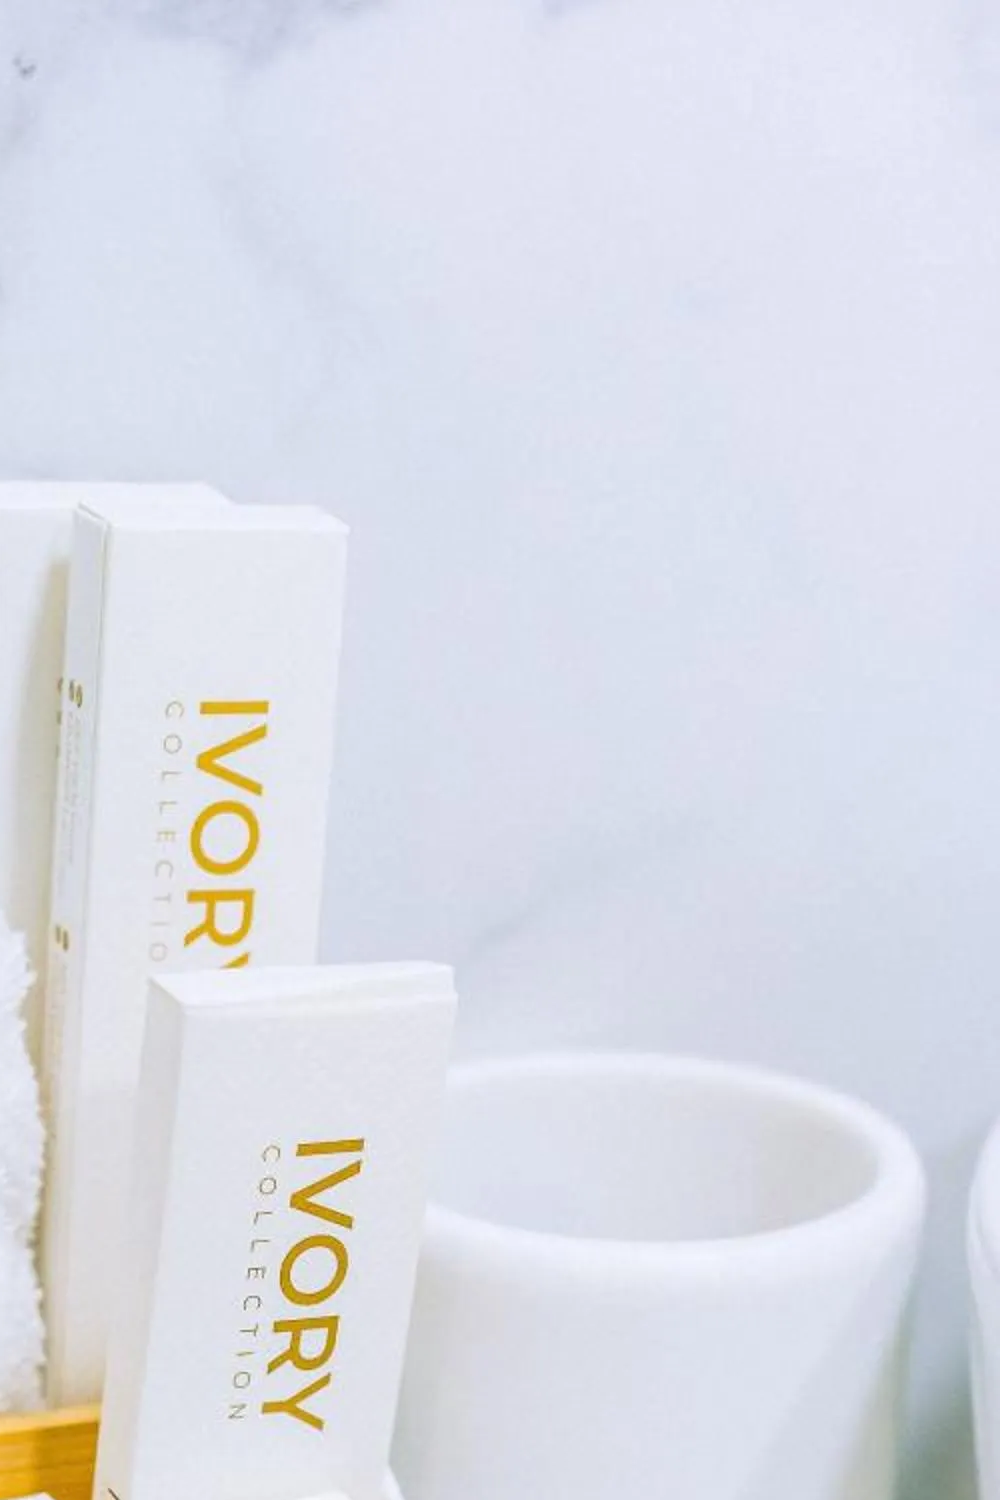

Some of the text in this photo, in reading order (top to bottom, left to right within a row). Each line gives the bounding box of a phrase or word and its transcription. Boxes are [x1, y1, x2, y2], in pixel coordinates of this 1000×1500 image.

[149, 700, 186, 962] COLLECTIO
[183, 699, 270, 969] IVOR
[227, 1144, 281, 1421] COLLECTION
[260, 1137, 366, 1431] IVORY
